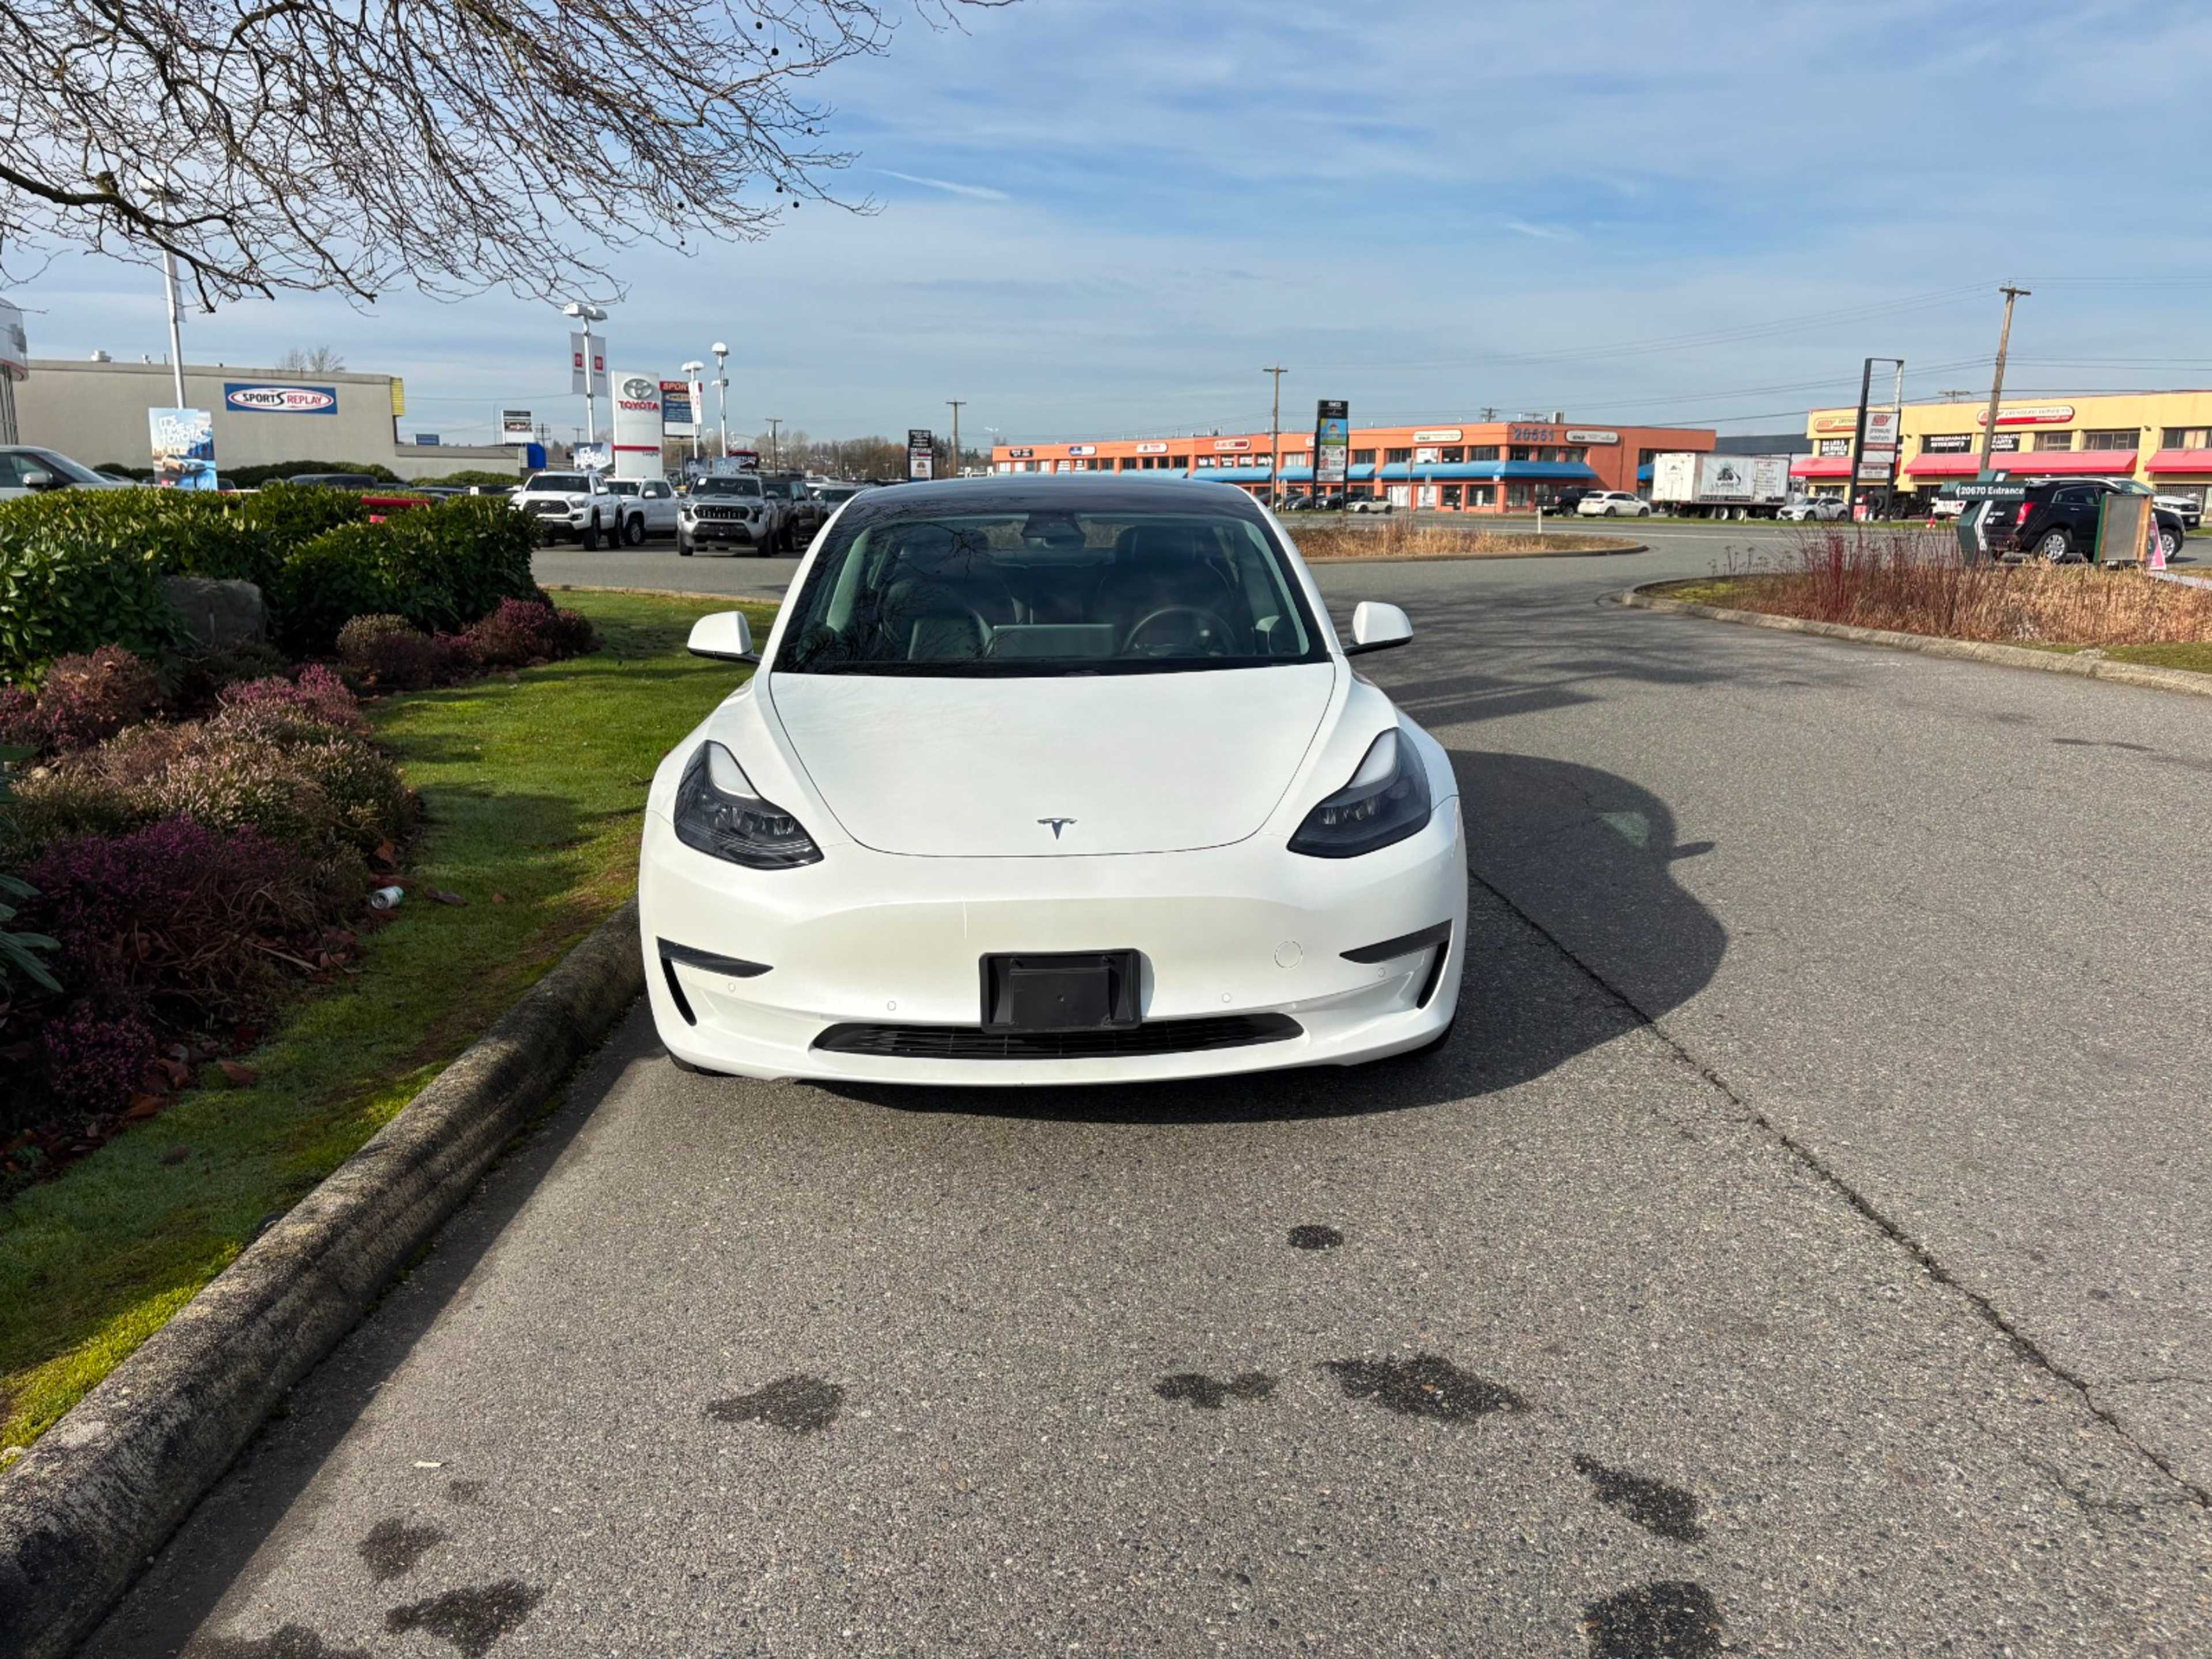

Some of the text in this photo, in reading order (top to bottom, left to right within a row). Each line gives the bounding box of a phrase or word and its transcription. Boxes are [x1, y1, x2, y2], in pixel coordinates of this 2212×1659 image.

[243, 391, 322, 406] SPORTS REPLAY
[618, 400, 660, 411] TOYOTA
[1960, 486, 2025, 495] 20670 Entrance
